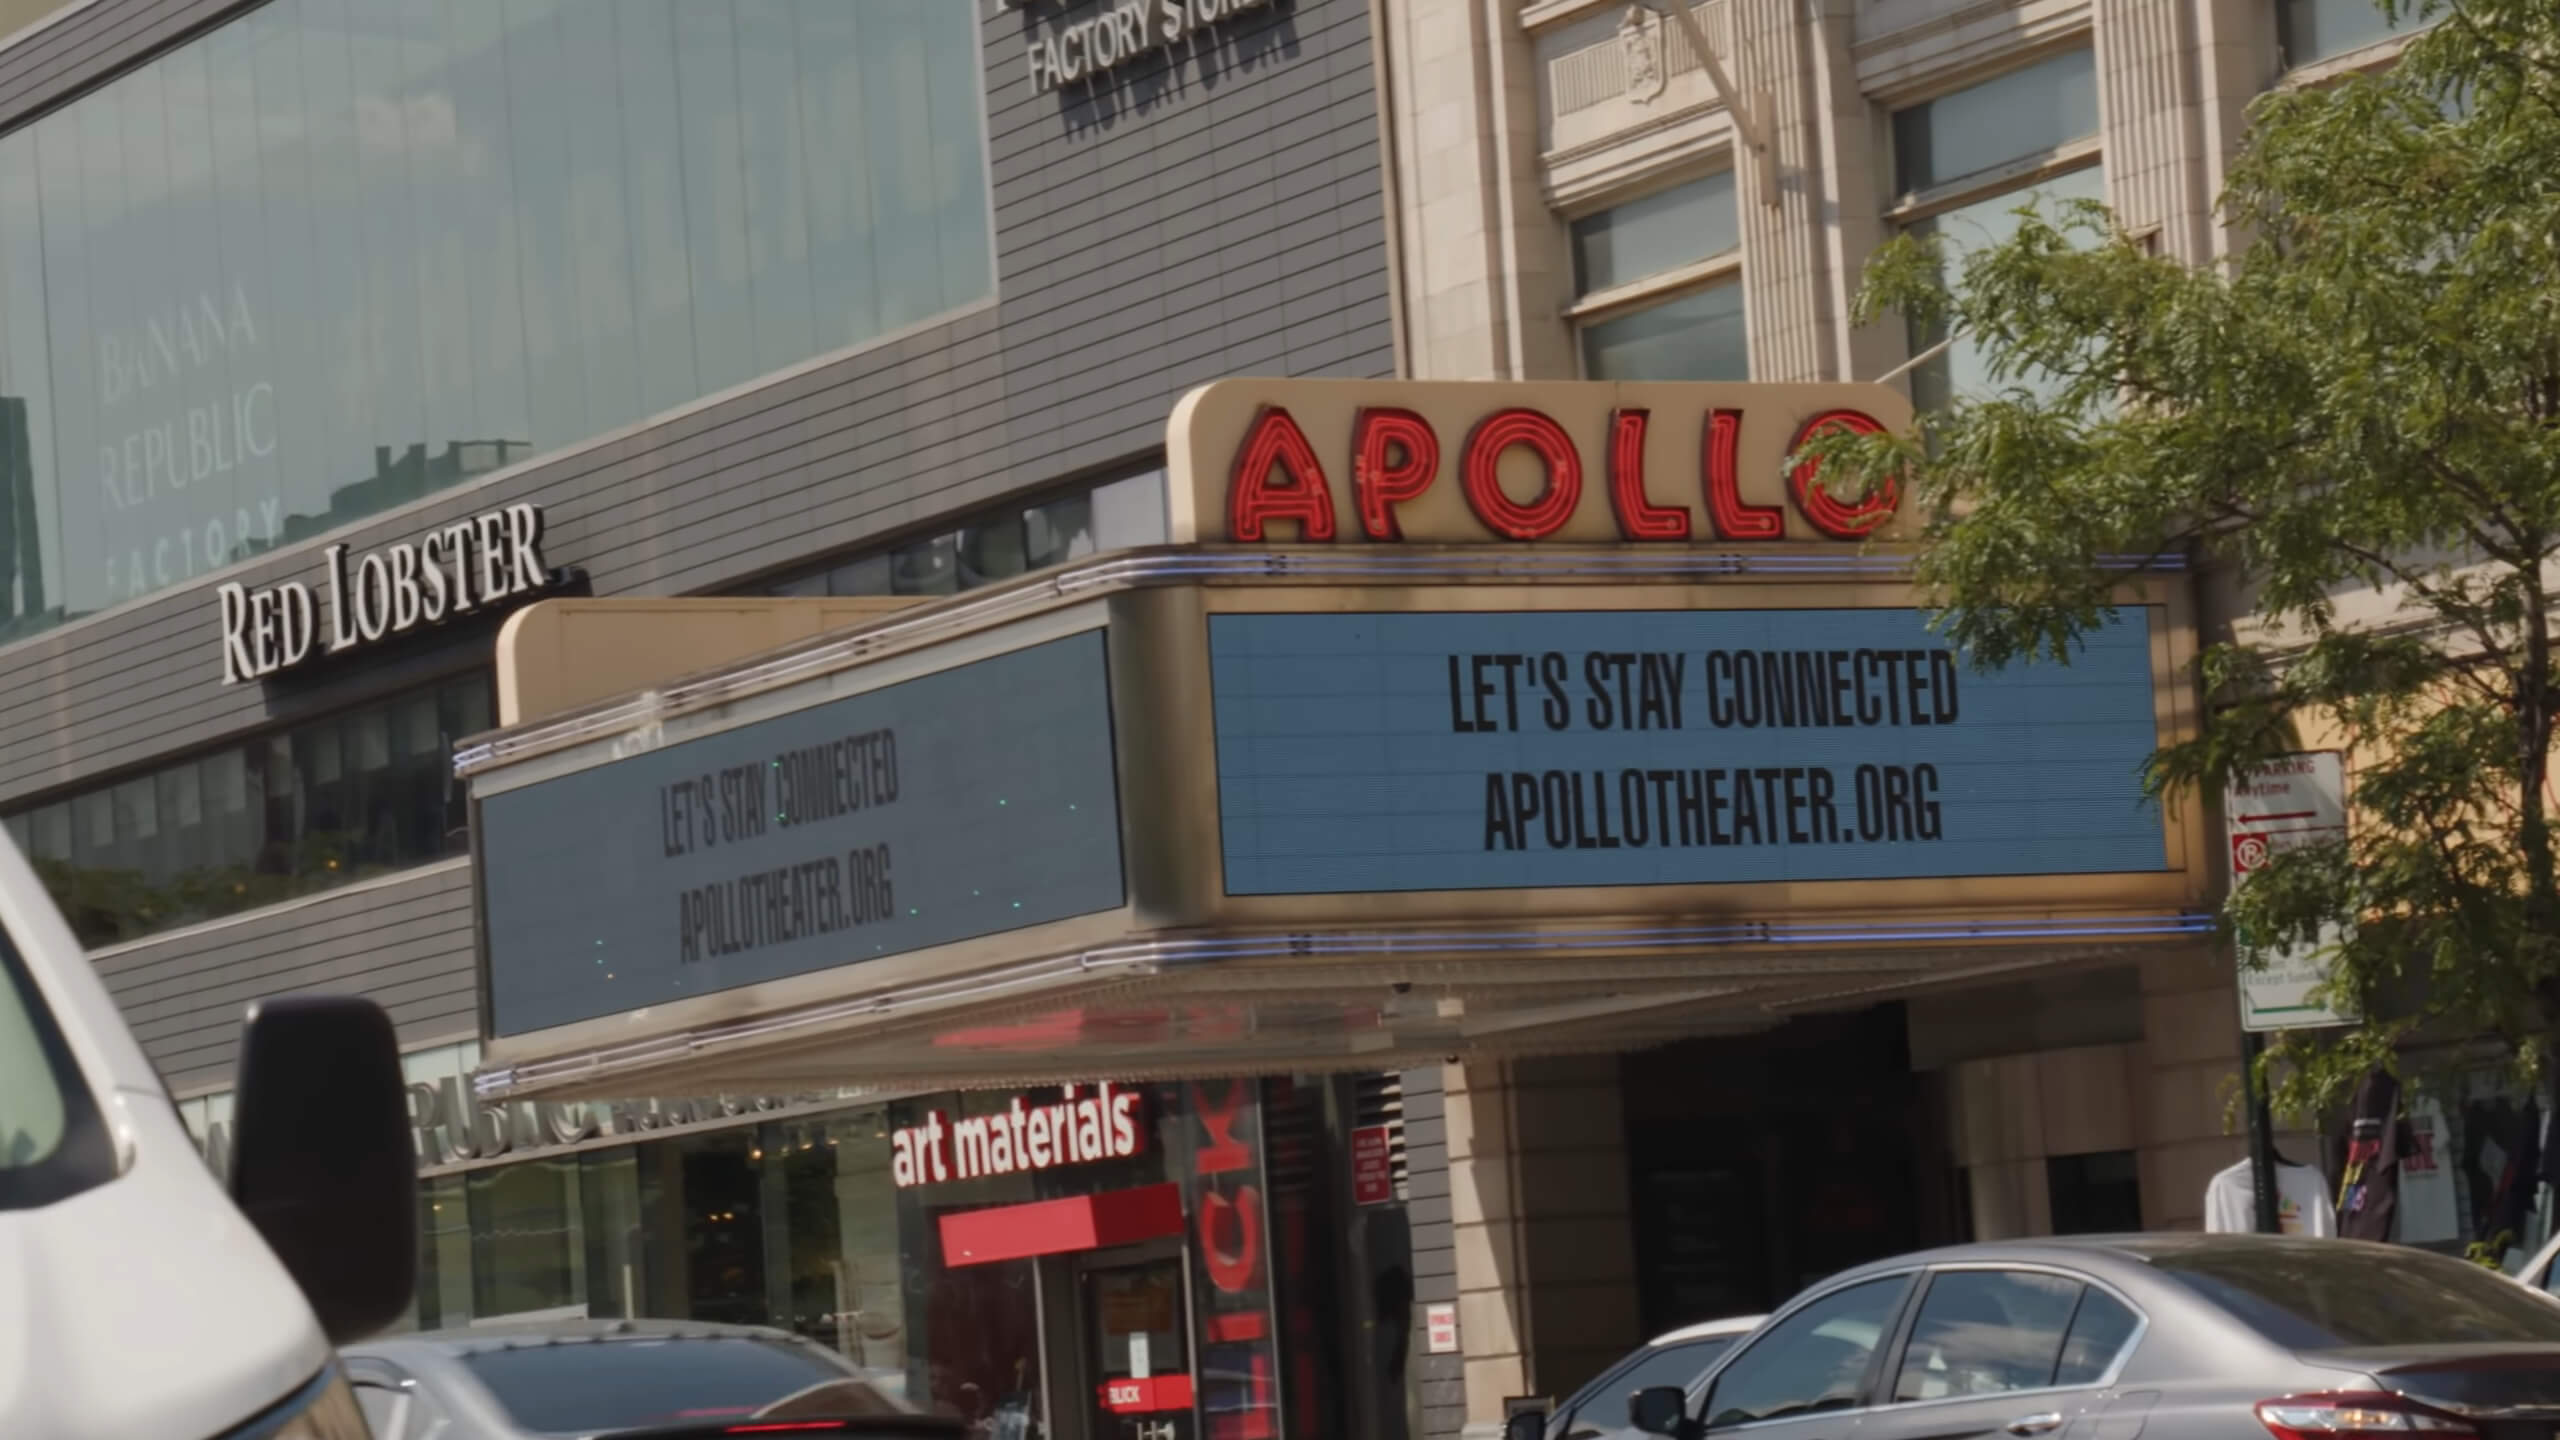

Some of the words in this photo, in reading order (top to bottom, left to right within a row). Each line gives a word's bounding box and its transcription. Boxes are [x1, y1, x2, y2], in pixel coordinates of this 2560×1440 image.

[1028, 0, 1150, 96] FACTORY
[98, 279, 257, 408] BANANA
[100, 378, 277, 512] REPUBLIC
[1227, 405, 1906, 543] APOLLO
[217, 580, 314, 687] RED
[324, 502, 546, 652] LOBSTER
[1447, 651, 1571, 733] LET'S
[1584, 650, 1686, 732] STAY
[1705, 647, 1960, 729] CONNECTED
[660, 772, 717, 859] LET'S
[720, 760, 767, 844] STAY
[774, 727, 898, 829] CONNECTED
[1483, 762, 1943, 852] APOLLOTHEATER.ORG
[679, 842, 895, 966] APOLLOTHEATER.ORG
[892, 1110, 947, 1188] art
[953, 1080, 1135, 1180] materials
